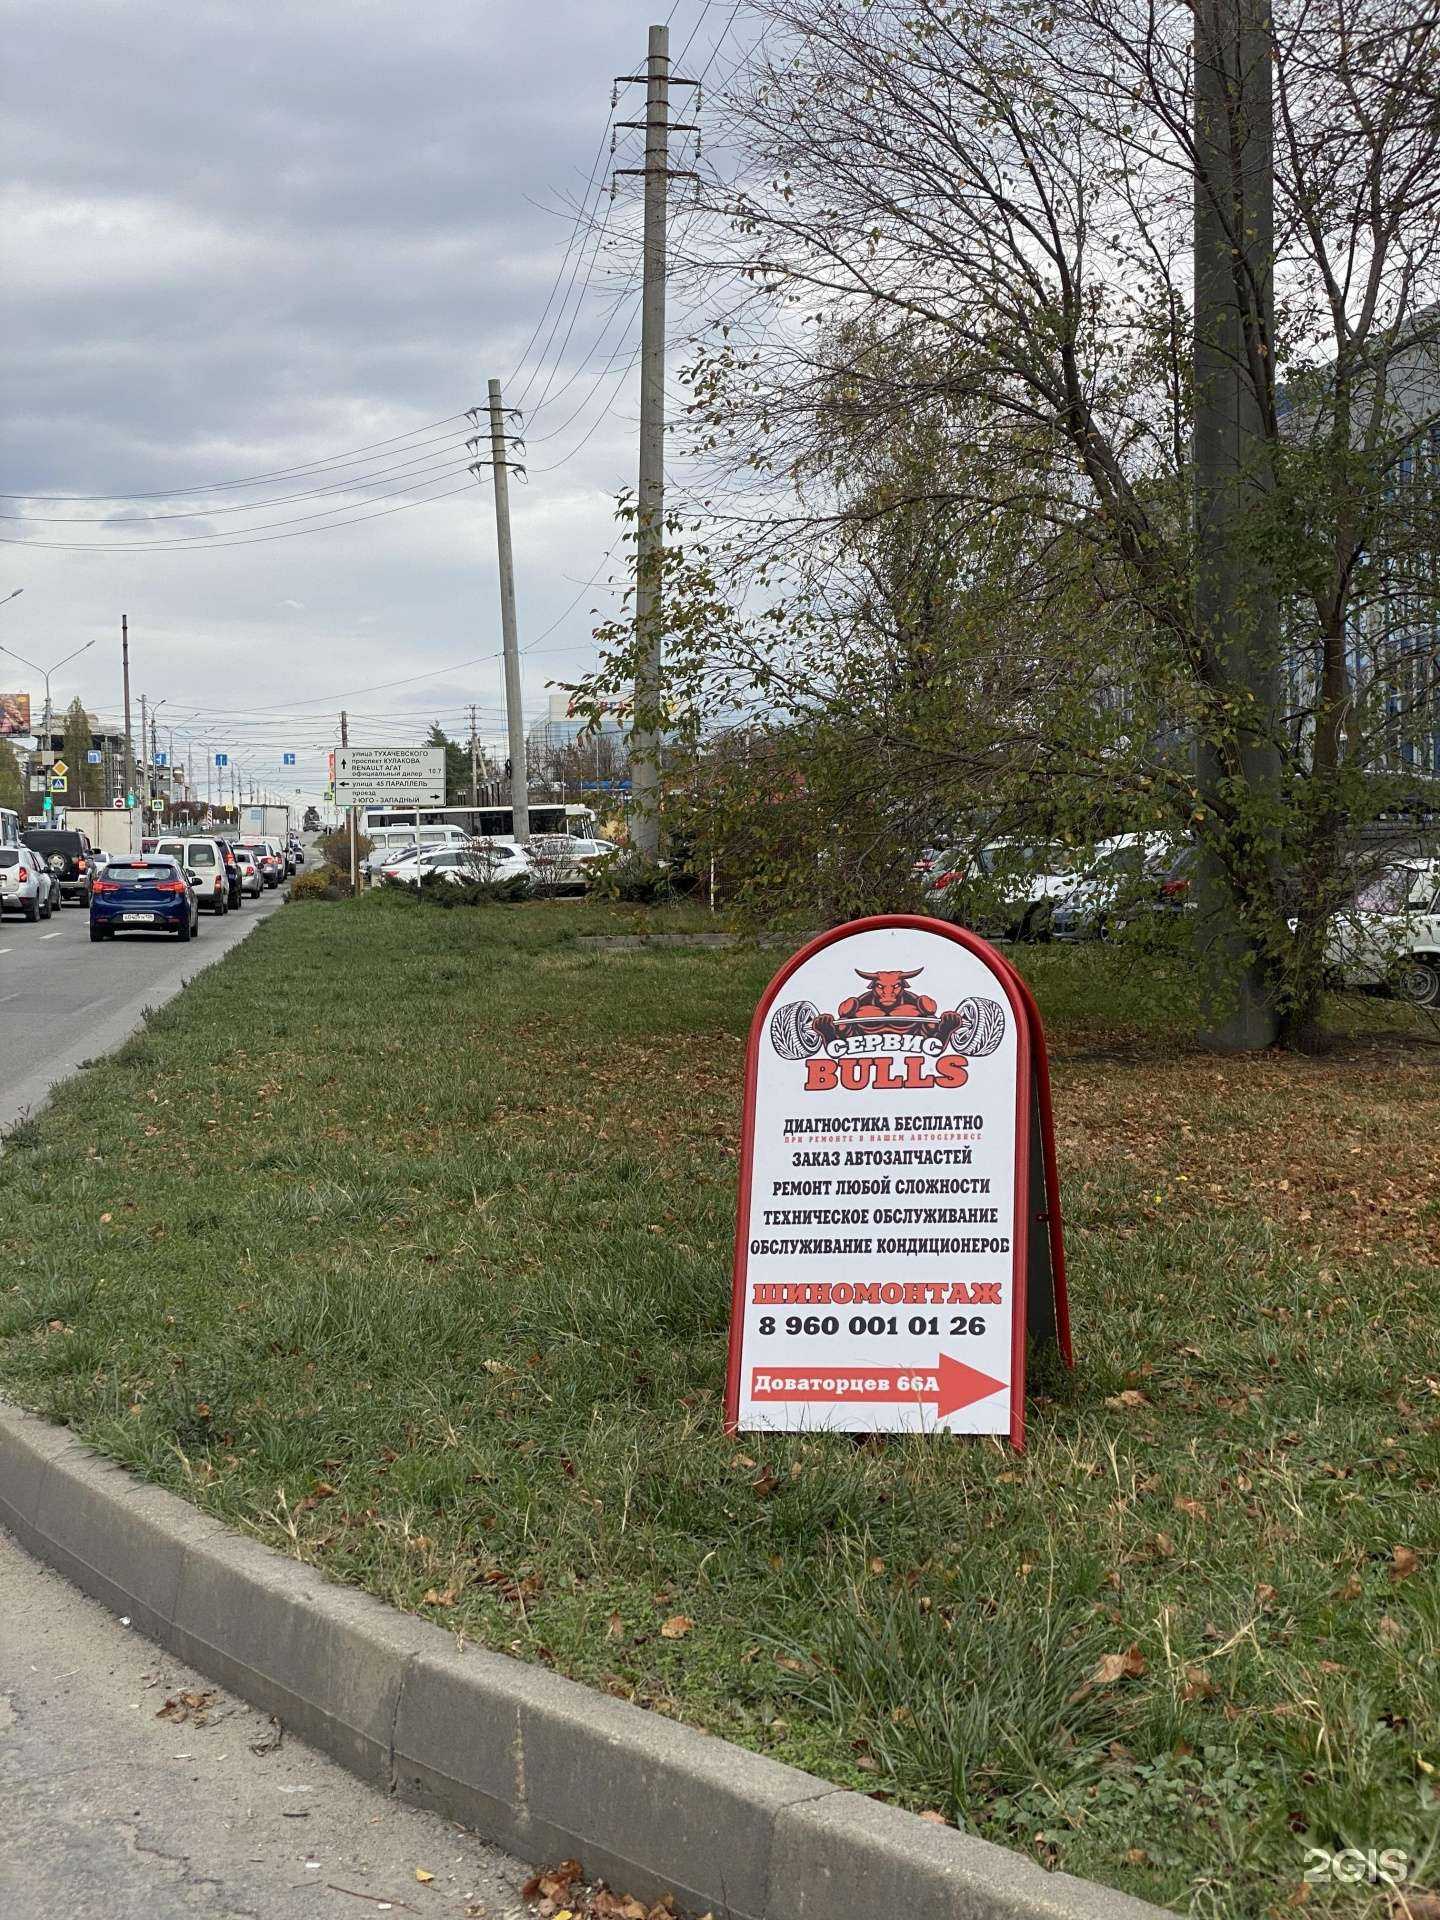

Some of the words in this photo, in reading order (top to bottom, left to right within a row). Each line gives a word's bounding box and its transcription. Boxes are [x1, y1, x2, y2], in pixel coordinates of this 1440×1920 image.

[825, 1034, 944, 1058] СЕРВИС
[804, 1055, 969, 1091] BULLS
[783, 1118, 890, 1136] ДИАГНОСТИКА
[894, 1115, 983, 1132] БЕСПЛАТНО
[870, 1134, 905, 1142] НАШЕМ
[910, 1133, 982, 1141] АВТОСЕРВИСЕ
[792, 1152, 840, 1167] ЗАКАЗ
[844, 1146, 972, 1165] АВТОЗАПЧАСТЕЙ
[773, 1180, 832, 1196] РЕМОНТ
[835, 1175, 891, 1195] ЛЮБОЙ
[895, 1178, 990, 1194] СЛОЖНОСТИ
[764, 1209, 869, 1225] ТЕХНИЧЕСКОЕ
[873, 1208, 998, 1223] ОБСЛУЖИВАНИЕ
[751, 1239, 872, 1254] ОБСЛУЖИВАНИЕ
[877, 1238, 1010, 1256] КОНДИЦИОНЕРОВ
[752, 1282, 1002, 1305] ШИНОМОНТАЖ
[759, 1318, 775, 1336] 8
[785, 1317, 839, 1336] 960
[849, 1317, 897, 1335] 001
[909, 1317, 939, 1335] 01
[950, 1317, 986, 1335] 26
[754, 1376, 889, 1393] Доваторцев
[897, 1376, 940, 1391] 66А
